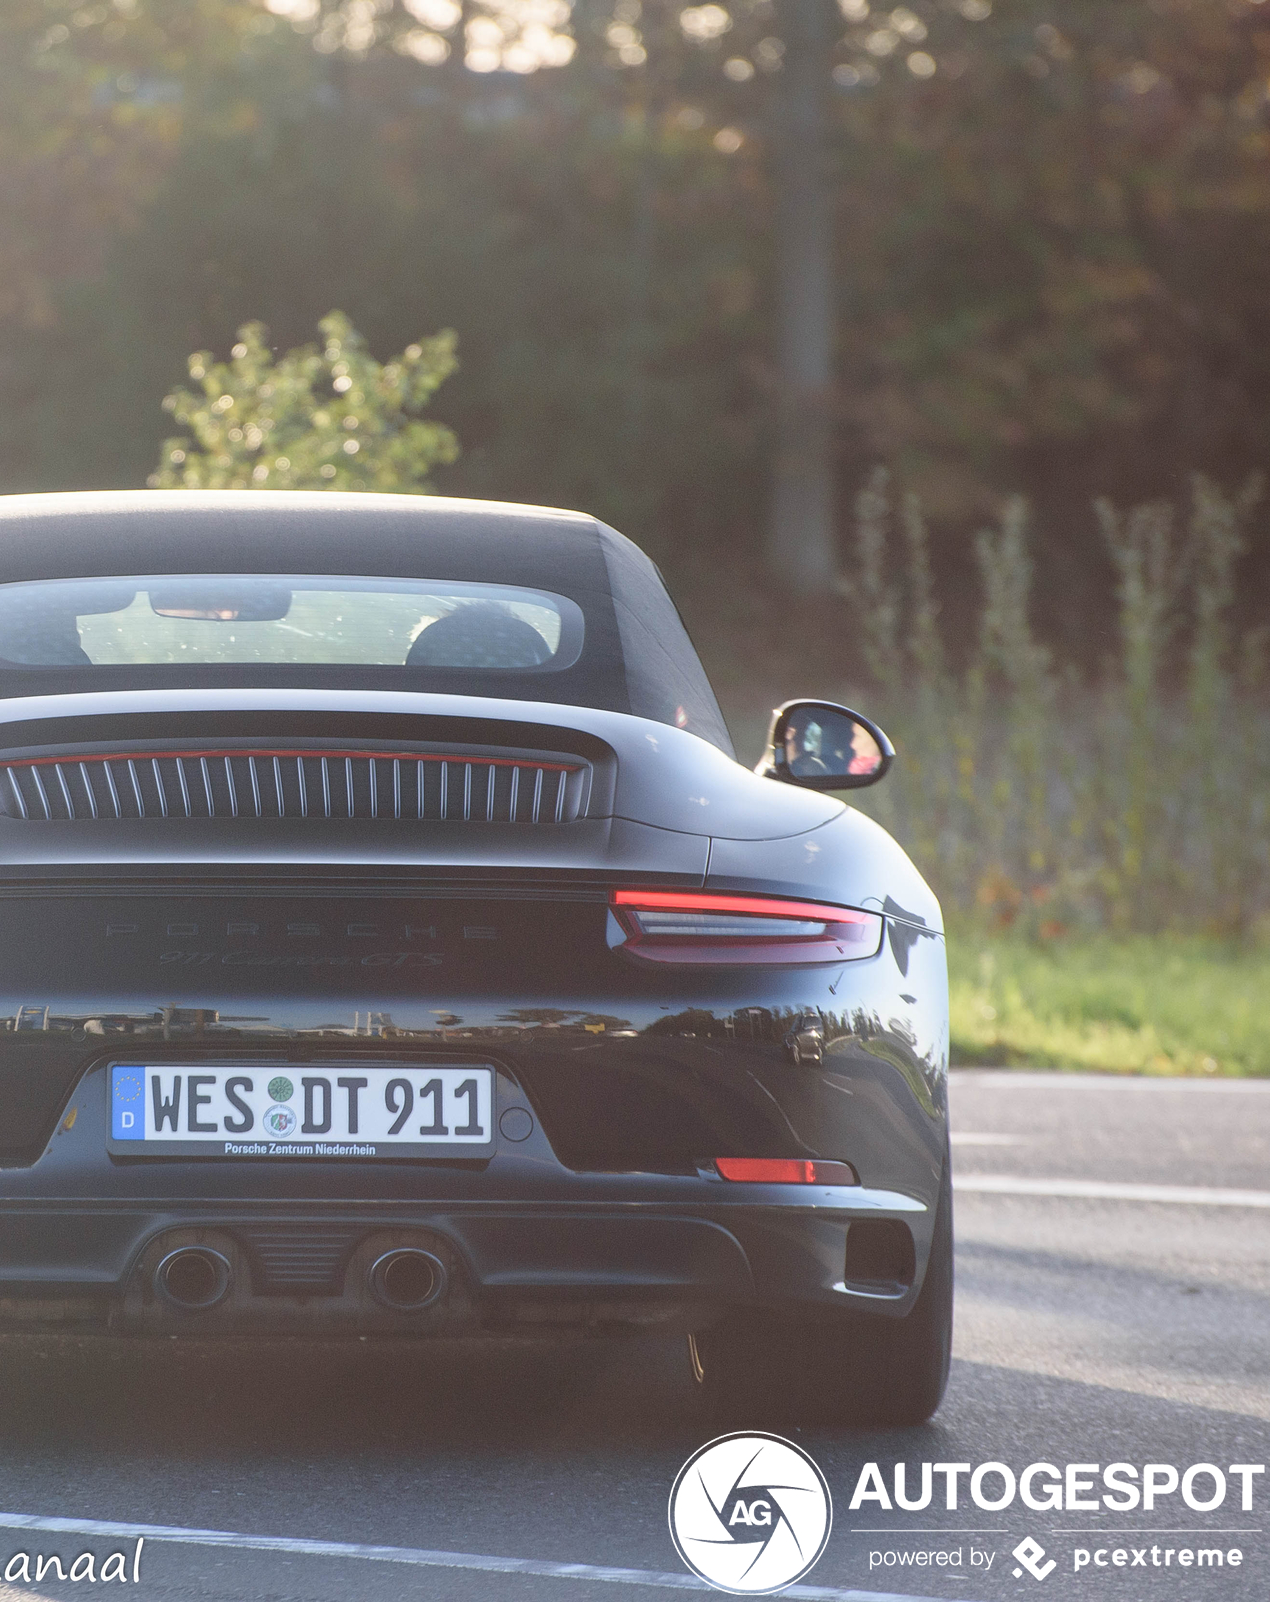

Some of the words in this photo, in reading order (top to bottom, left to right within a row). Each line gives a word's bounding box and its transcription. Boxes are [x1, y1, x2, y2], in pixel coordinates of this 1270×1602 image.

[105, 922, 497, 940] PORSCHE
[159, 950, 216, 966] 911
[220, 950, 360, 966] Carrera
[360, 951, 445, 967] GTS
[151, 1075, 254, 1133] WES
[300, 1077, 368, 1135] DT
[384, 1078, 484, 1136] 911
[121, 1111, 135, 1128] D
[224, 1142, 267, 1154] Porsche
[268, 1143, 313, 1155] Zentrum
[315, 1143, 376, 1155] Niederrhein
